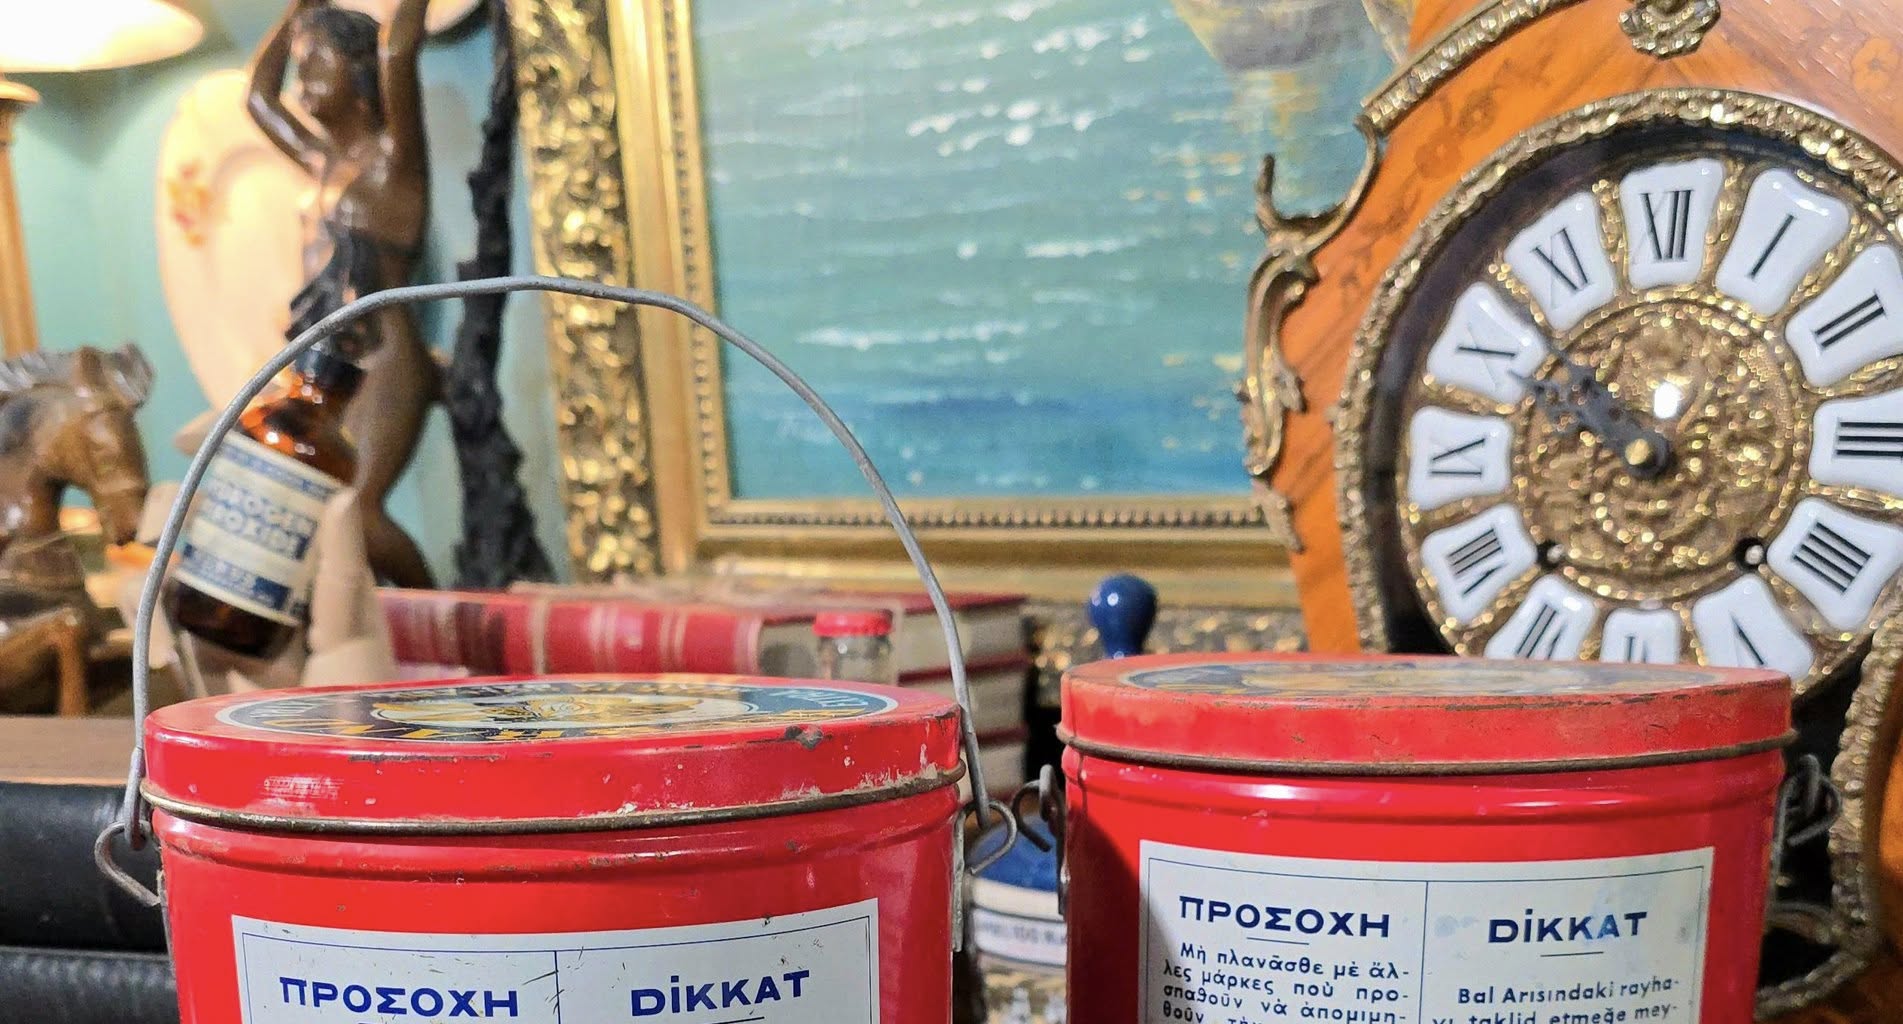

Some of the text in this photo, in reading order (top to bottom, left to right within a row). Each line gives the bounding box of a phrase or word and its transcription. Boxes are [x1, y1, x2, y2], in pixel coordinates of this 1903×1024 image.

[1179, 896, 1390, 938] ΠΡΟΣΟΧΗ
[1488, 909, 1647, 943] DİKKAT
[1163, 959, 1191, 982] λες
[279, 977, 519, 1017] ΠΡΟΣΟΧΗ
[631, 970, 809, 1017] DİKKAT
[1458, 976, 1679, 1004] Bal Arısındaki rayha-
[1635, 1003, 1678, 1021] mey-
